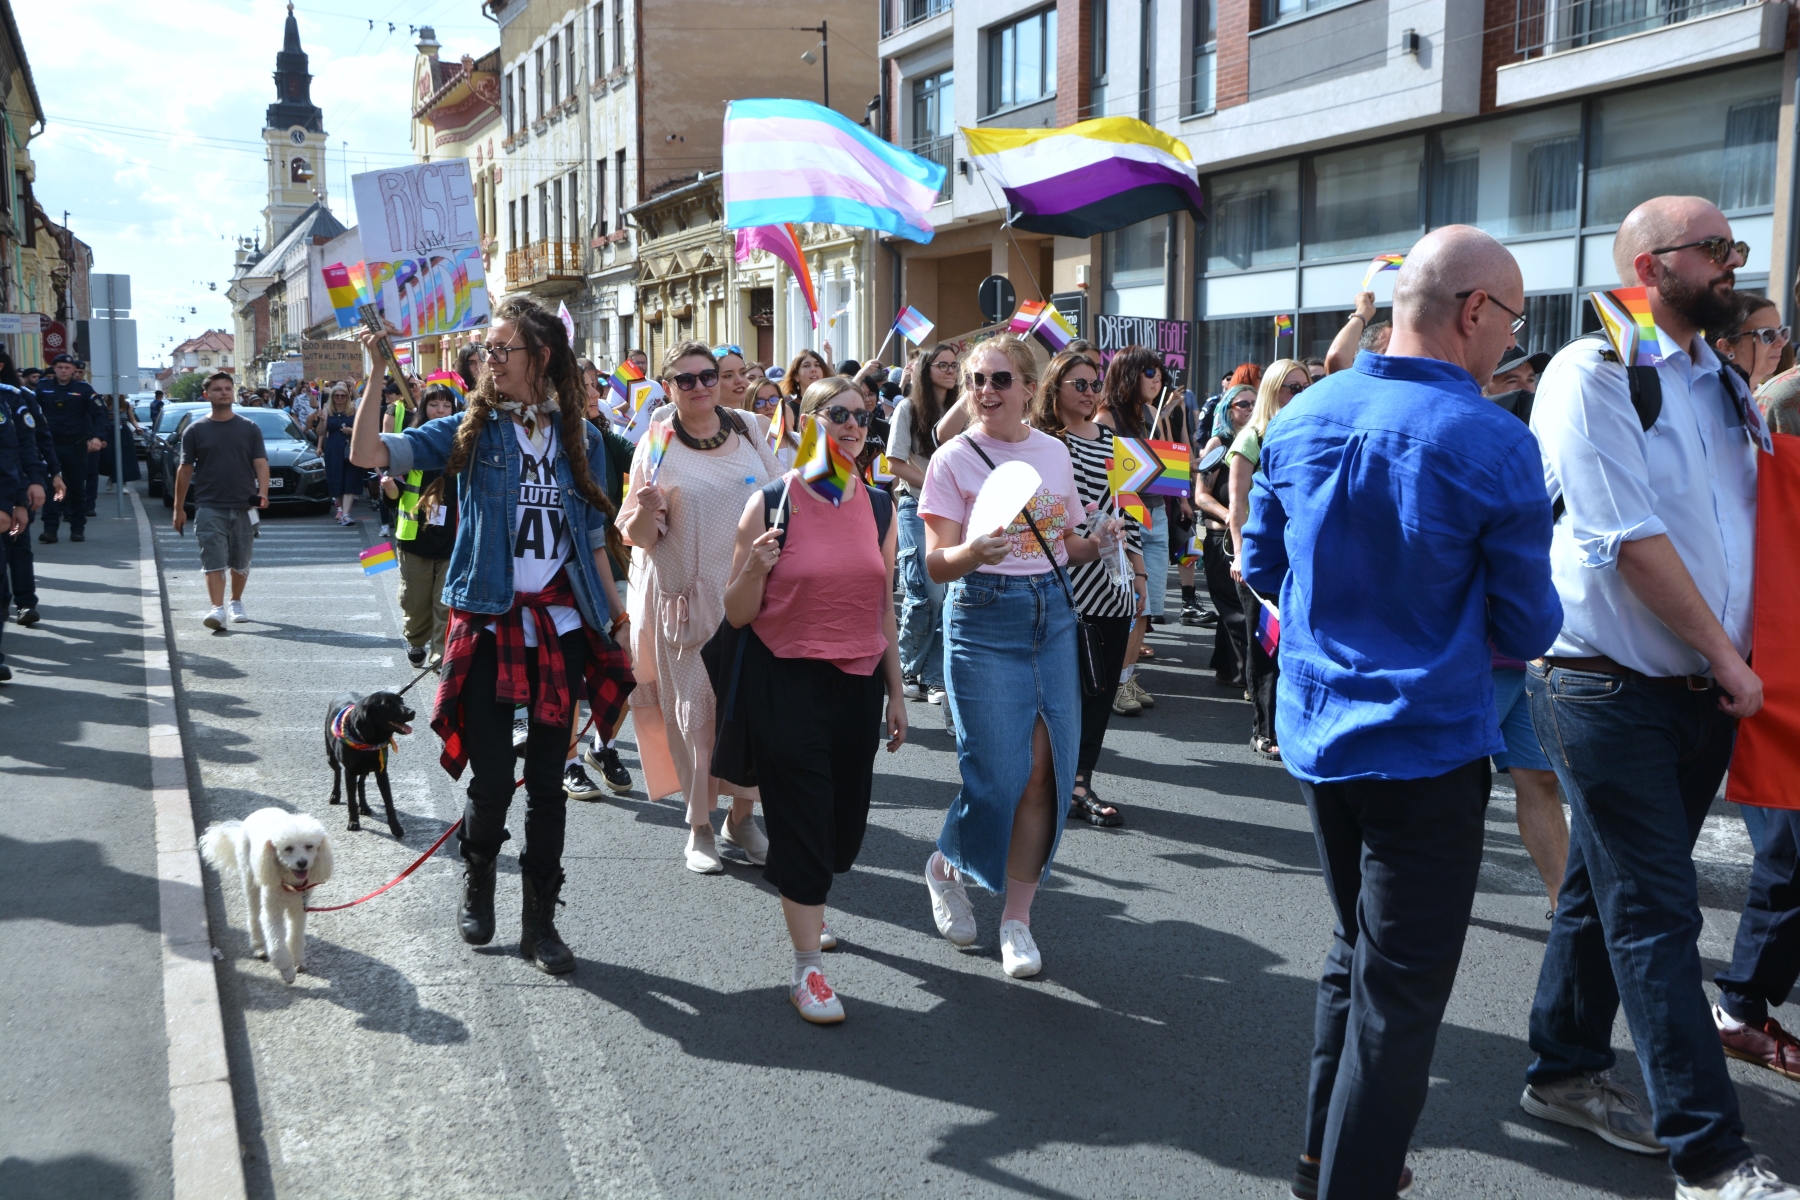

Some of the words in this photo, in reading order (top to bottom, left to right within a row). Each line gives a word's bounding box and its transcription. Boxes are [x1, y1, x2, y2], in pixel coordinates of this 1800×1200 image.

[377, 163, 473, 252] RISE
[367, 246, 488, 337] PRIDE
[302, 342, 320, 350] GOD
[322, 342, 336, 350] HELP
[1098, 315, 1157, 350] DREPTURI
[1158, 321, 1188, 354] EGALE
[303, 353, 323, 361] WITH
[519, 454, 559, 486] AK
[518, 486, 562, 505] LUTE
[514, 507, 566, 560] AY
